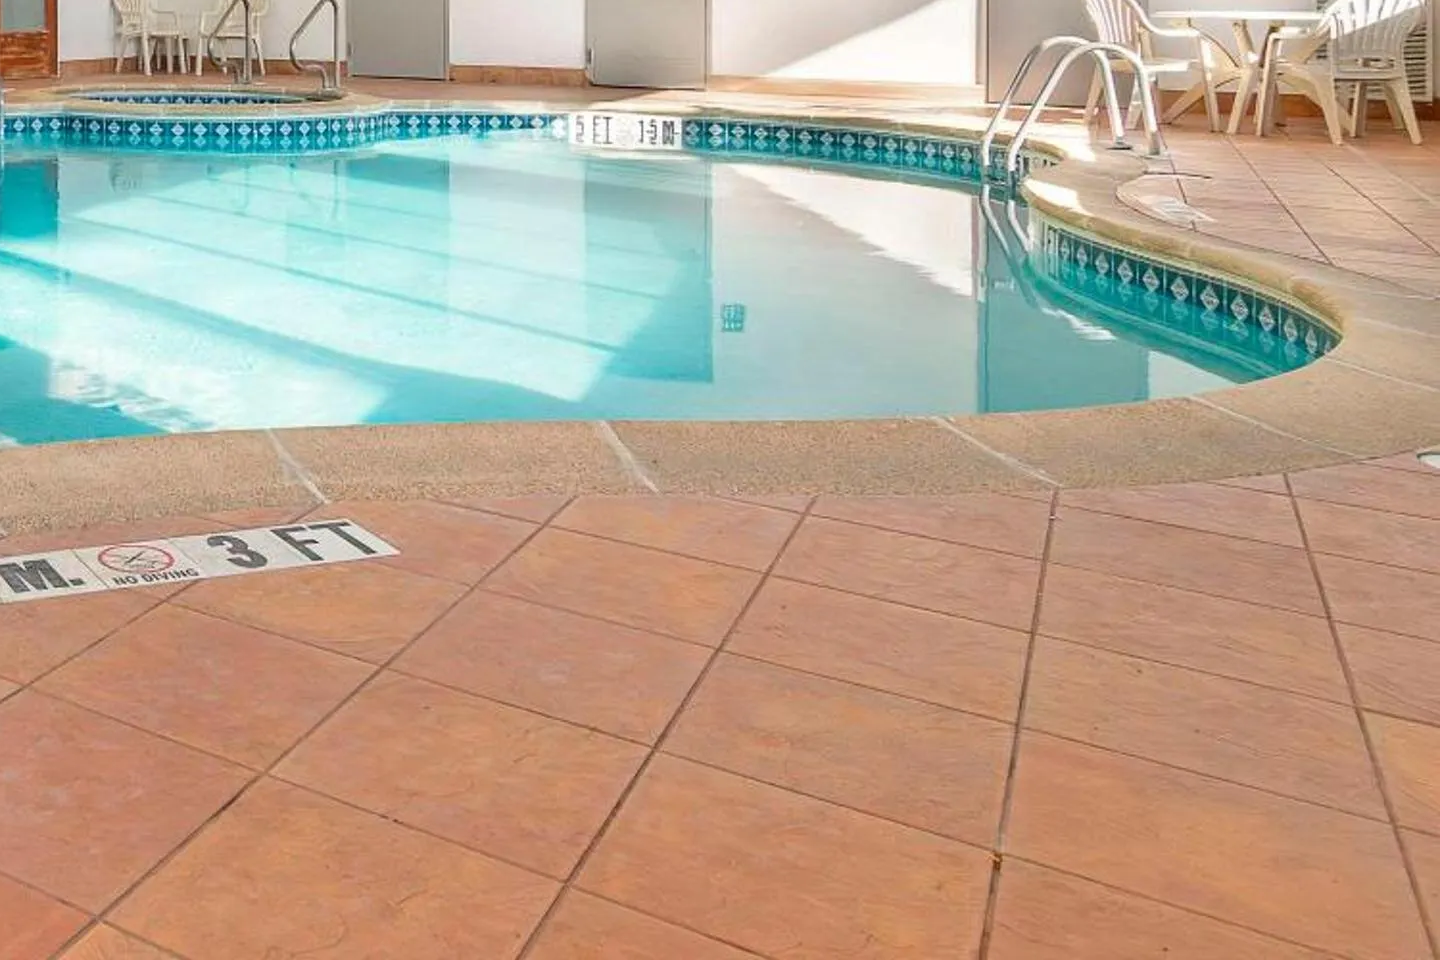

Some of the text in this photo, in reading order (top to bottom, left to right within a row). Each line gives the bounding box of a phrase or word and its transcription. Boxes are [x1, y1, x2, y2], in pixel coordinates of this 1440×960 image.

[206, 534, 268, 570] 3
[269, 521, 378, 562] FT
[112, 567, 200, 585] NO DIVING
